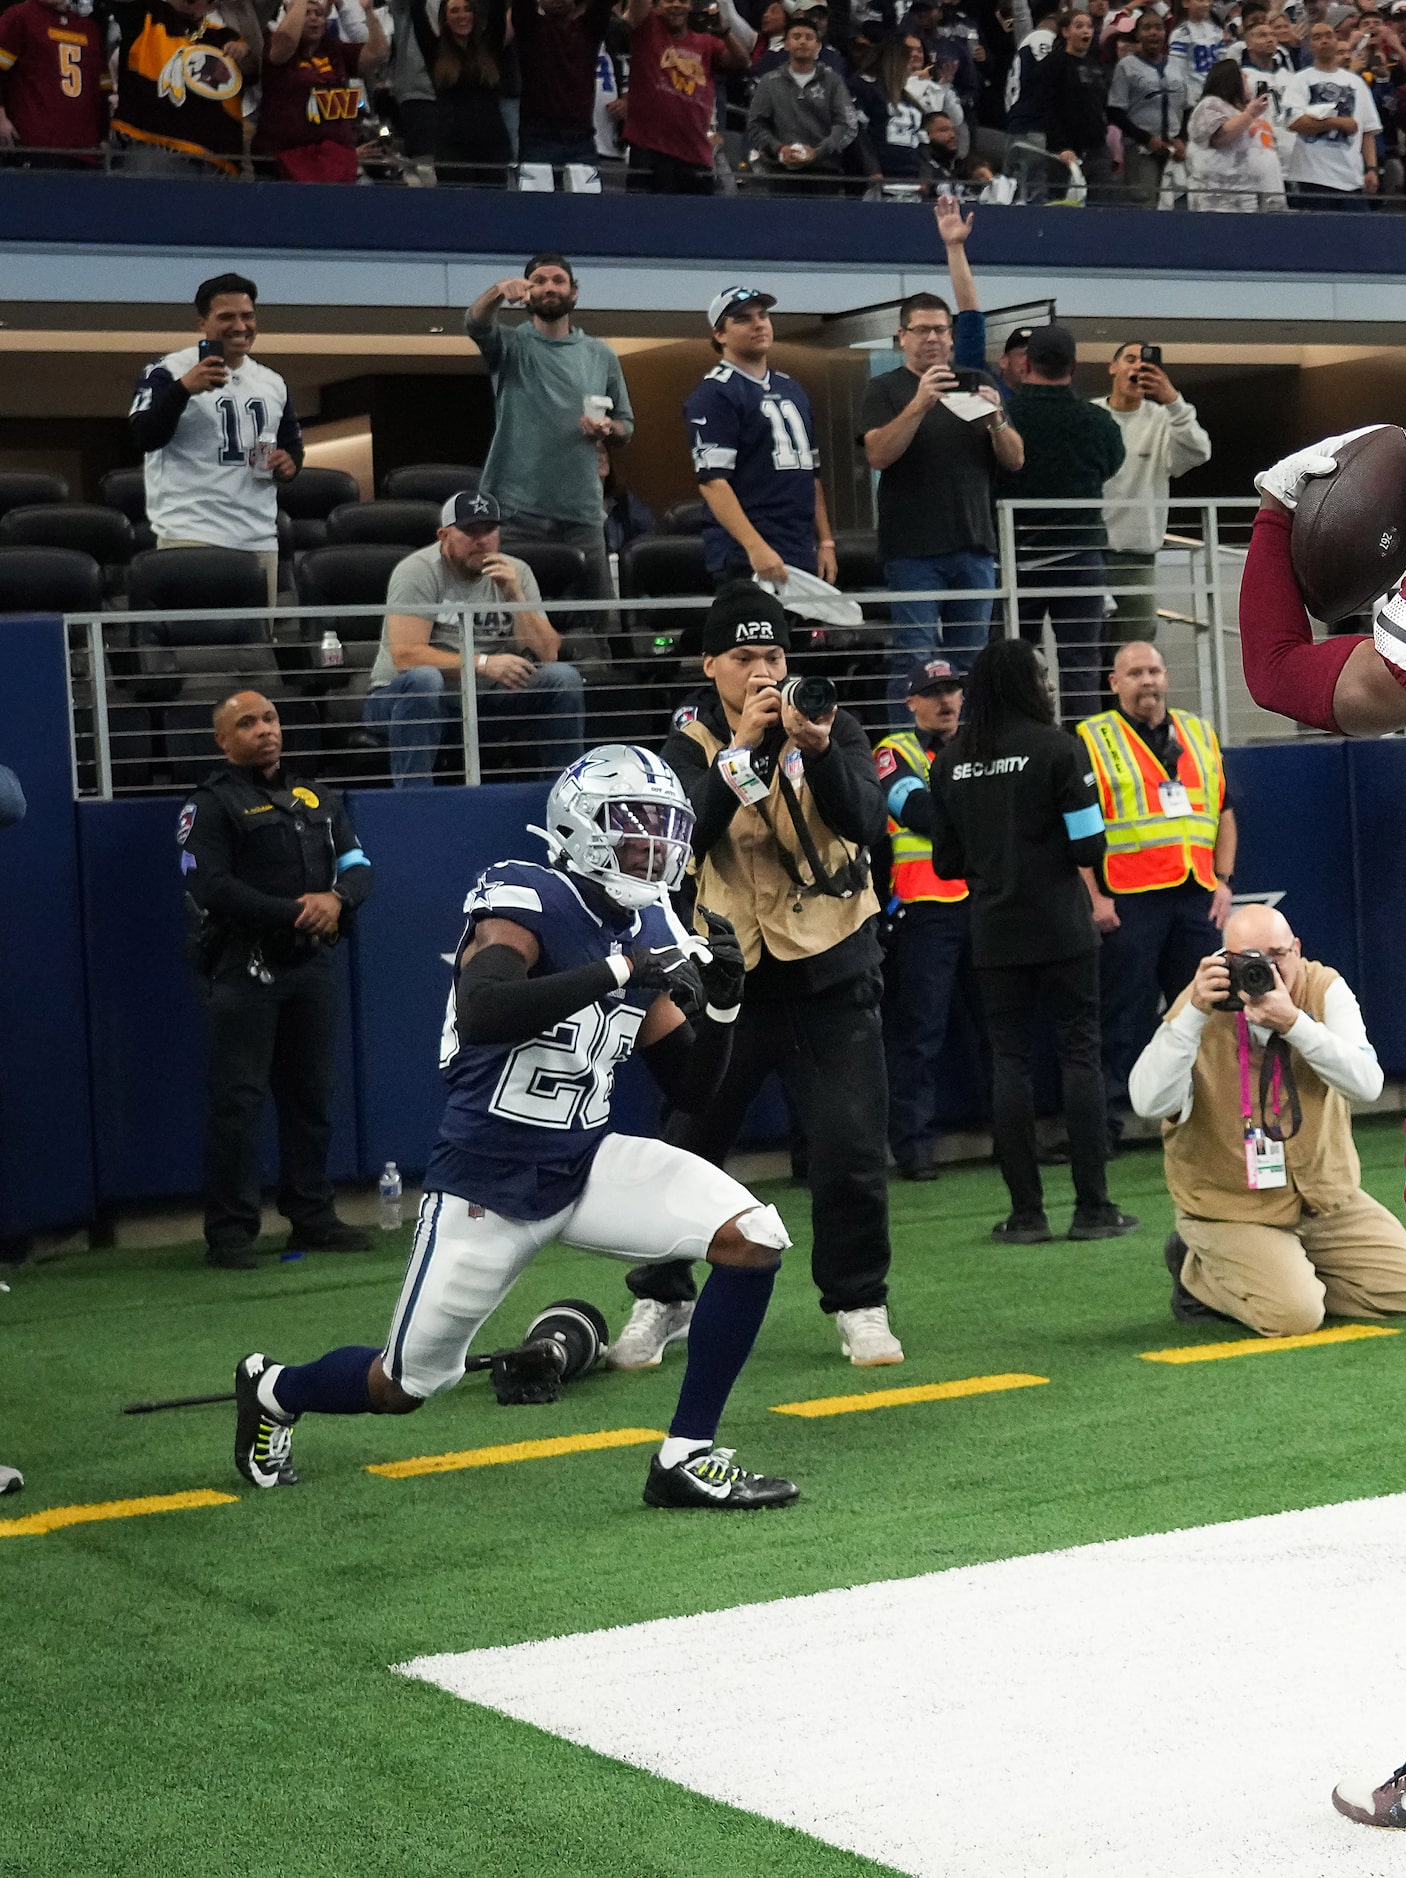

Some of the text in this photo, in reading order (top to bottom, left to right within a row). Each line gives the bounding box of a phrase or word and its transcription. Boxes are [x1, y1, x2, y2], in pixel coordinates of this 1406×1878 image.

[59, 43, 82, 98] 5
[312, 89, 362, 120] W
[216, 396, 268, 466] 11
[760, 400, 814, 470] 11
[1379, 532, 1393, 550] 267
[736, 621, 773, 638] APR
[952, 756, 1029, 781] SECURITY
[1101, 726, 1124, 774] FIRE
